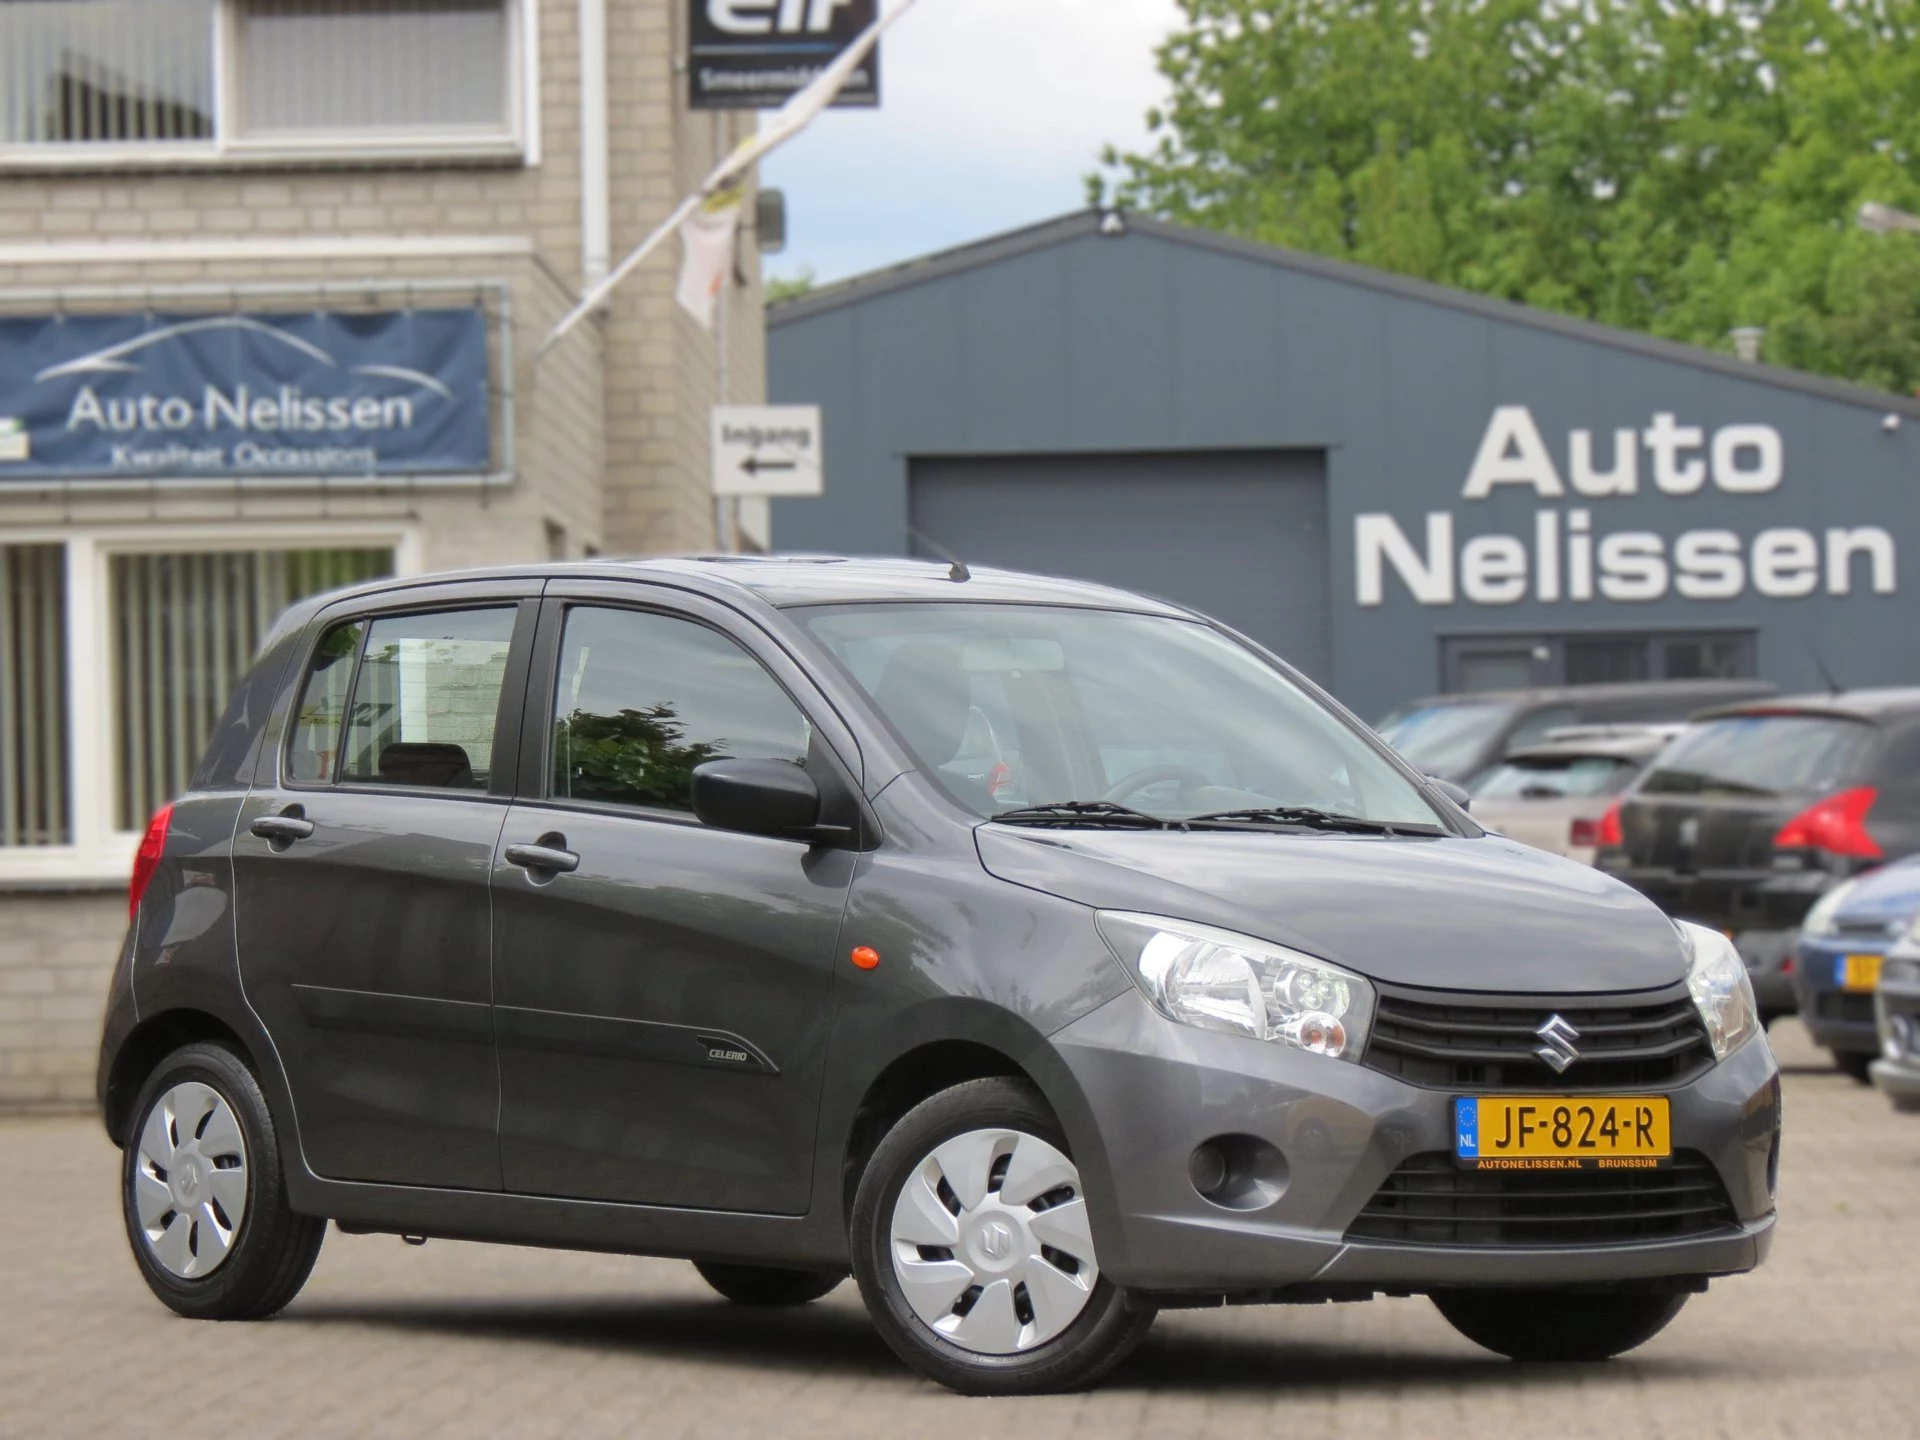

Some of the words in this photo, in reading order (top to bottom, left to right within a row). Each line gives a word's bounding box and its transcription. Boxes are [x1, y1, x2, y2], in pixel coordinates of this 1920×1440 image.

[66, 386, 193, 431] Auto
[204, 384, 413, 430] Nelissen
[721, 422, 811, 451] Ingang
[1461, 404, 1785, 500] Auto
[1353, 508, 1897, 606] Nelissen
[709, 1049, 747, 1061] CELERIO
[1460, 1134, 1476, 1147] NL
[1495, 1105, 1655, 1149] JF-824-R
[1477, 1159, 1582, 1169] AUTONELISSEN.NL
[1598, 1159, 1657, 1168] BRUNSSUM
